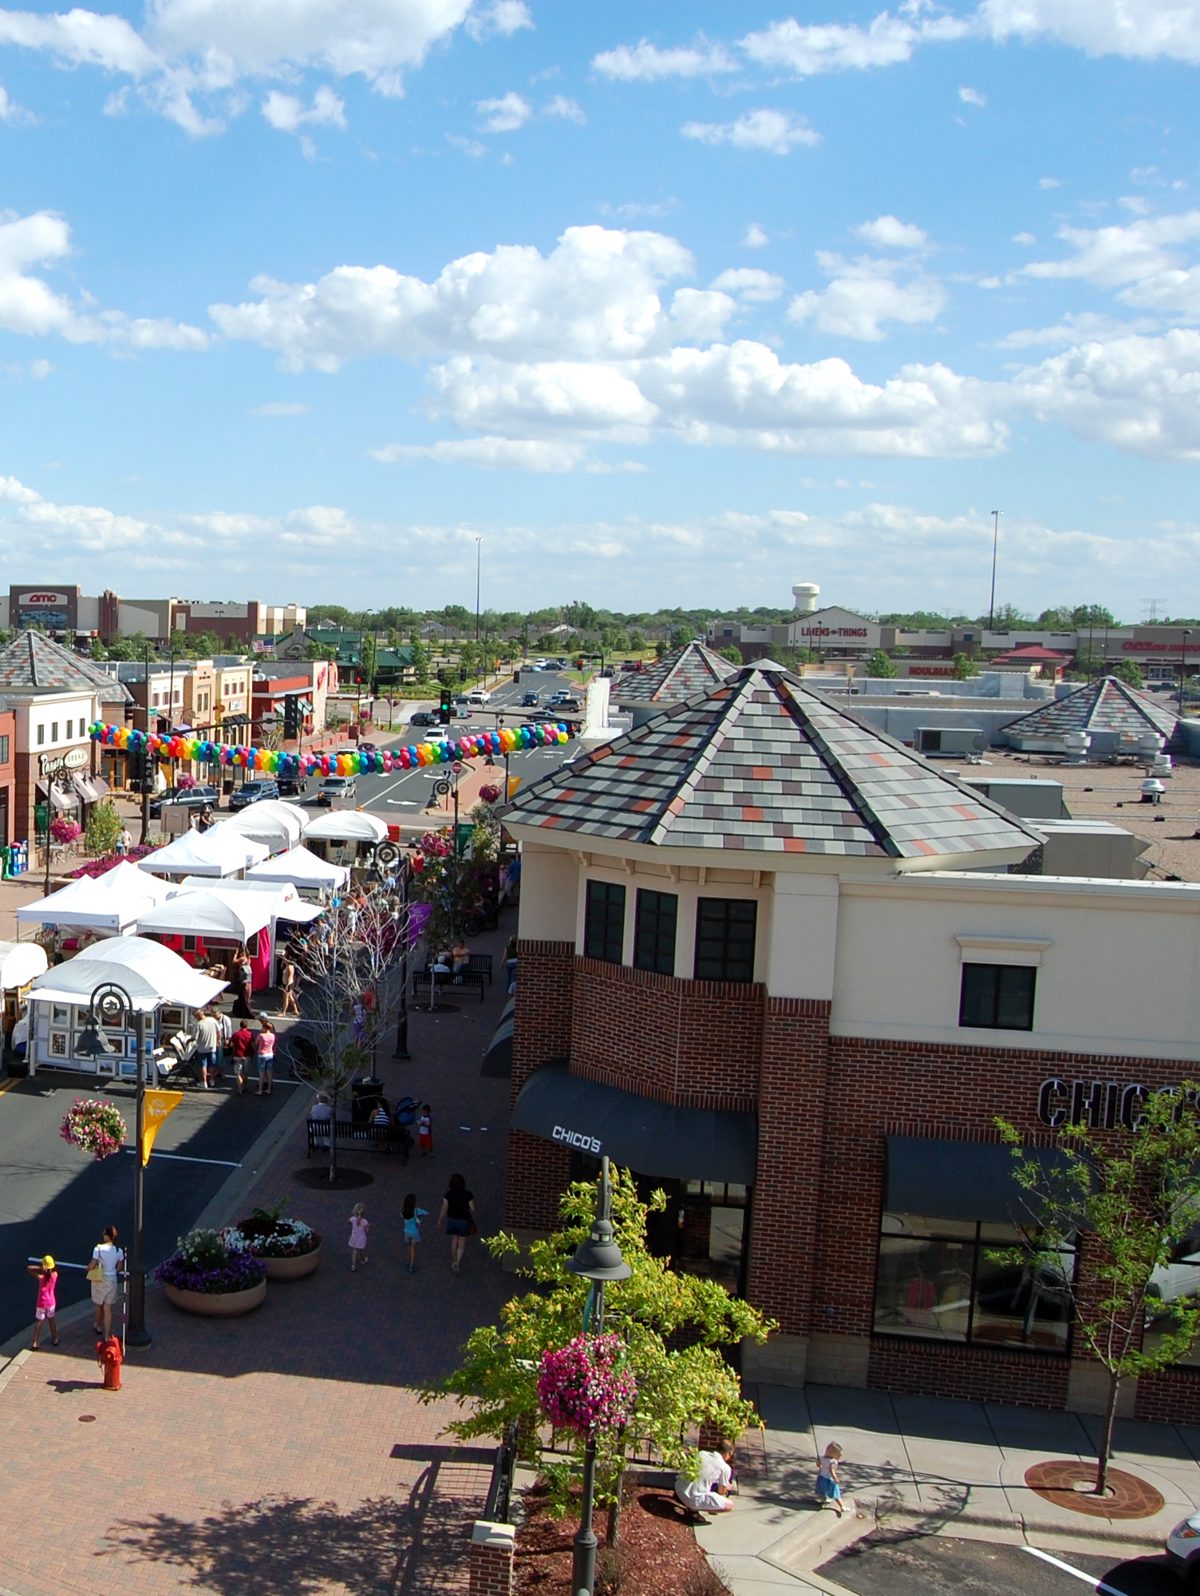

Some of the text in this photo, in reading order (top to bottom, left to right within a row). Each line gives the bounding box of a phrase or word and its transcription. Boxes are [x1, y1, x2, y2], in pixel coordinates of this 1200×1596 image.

[801, 627, 830, 636] LINENS
[838, 628, 868, 637] THINGS
[552, 1125, 602, 1153] CHICO'S
